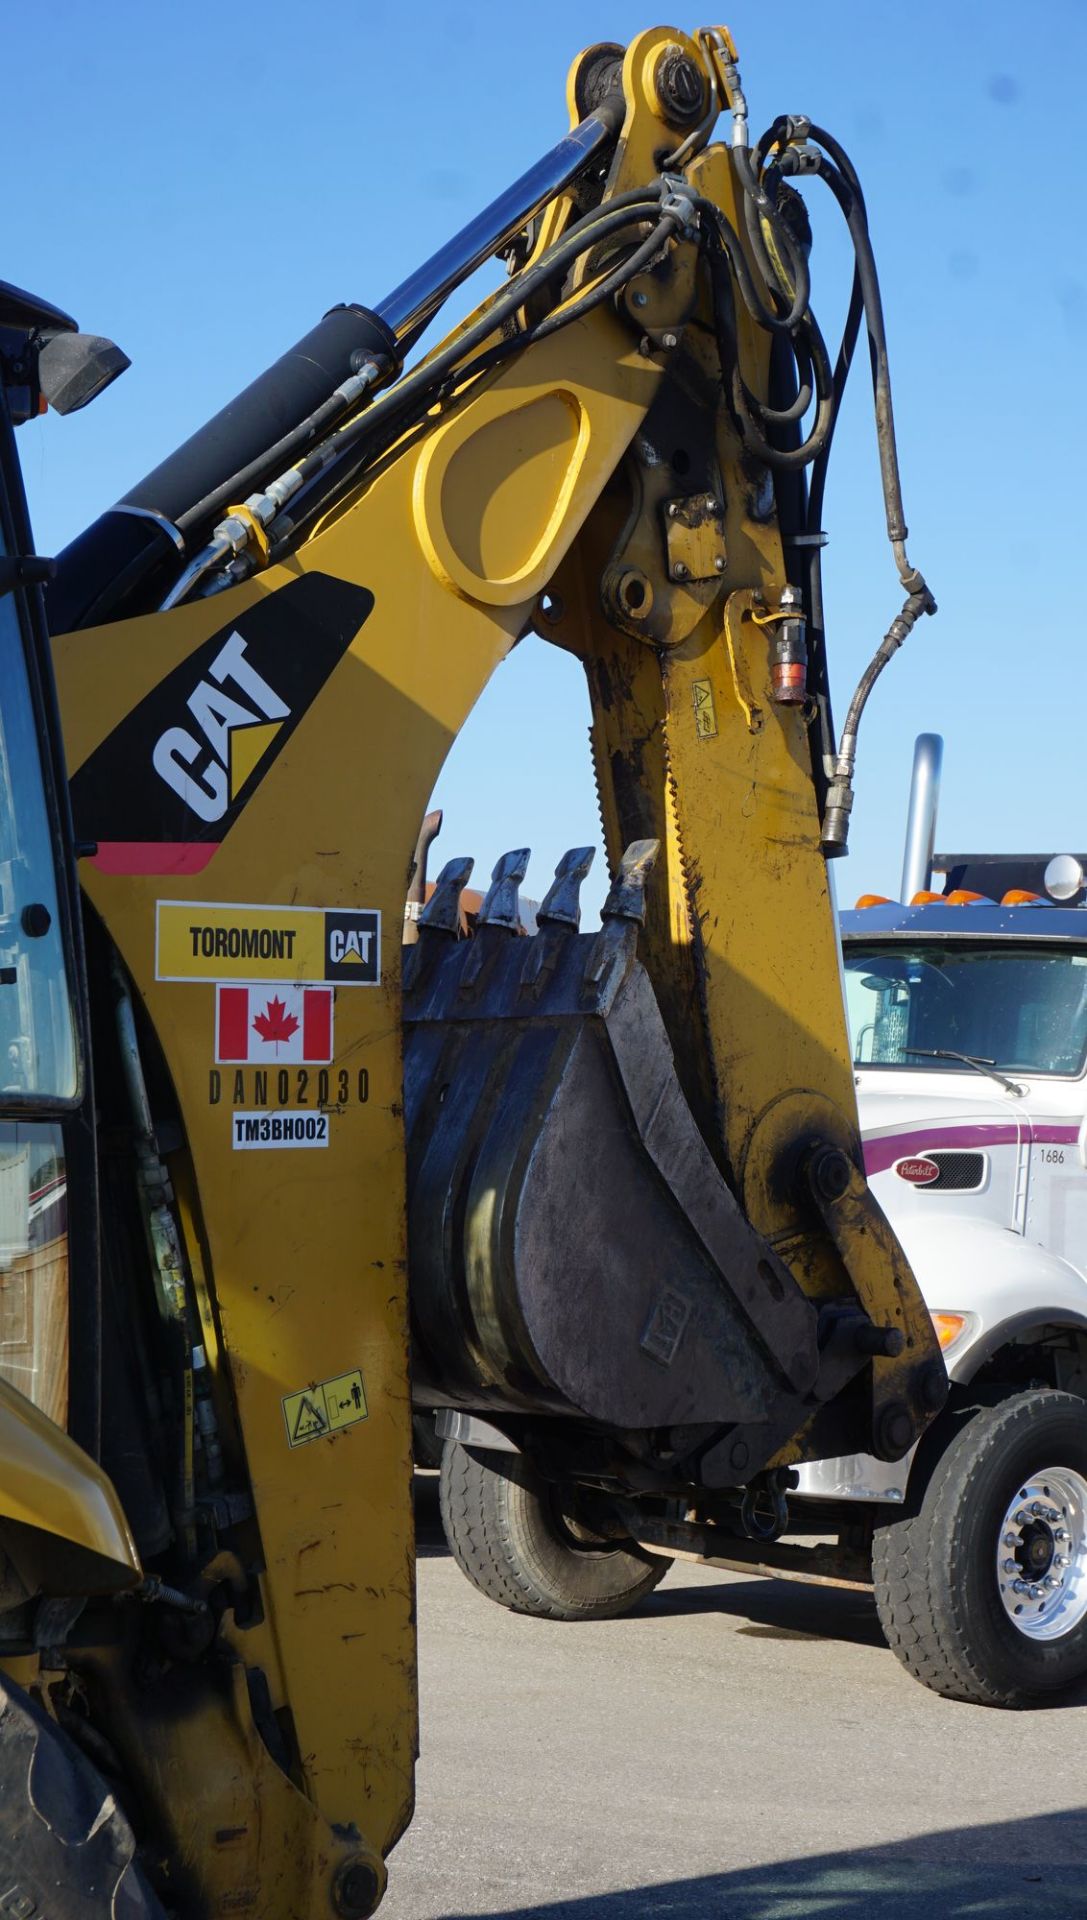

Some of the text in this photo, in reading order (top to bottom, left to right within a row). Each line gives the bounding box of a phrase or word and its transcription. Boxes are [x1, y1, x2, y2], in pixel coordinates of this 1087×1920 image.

[153, 630, 292, 823] CAT
[189, 926, 374, 964] TOROMONT CAT
[235, 1117, 327, 1142] TM3BH002
[901, 1162, 935, 1176] Peterbilt
[1041, 1149, 1065, 1164] 1686
